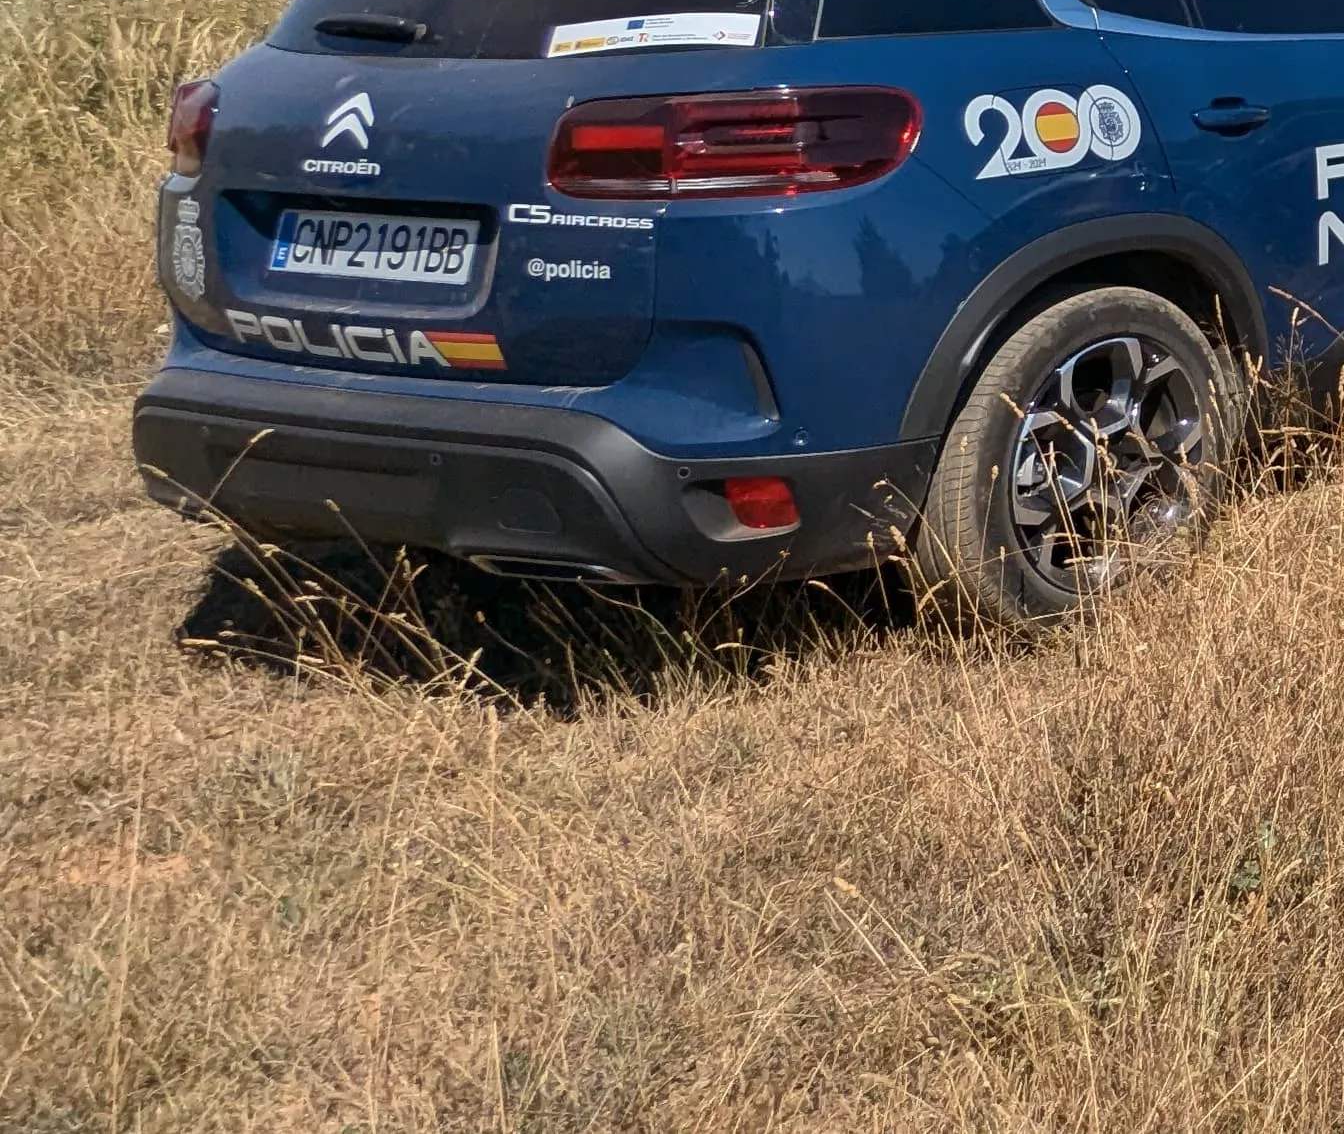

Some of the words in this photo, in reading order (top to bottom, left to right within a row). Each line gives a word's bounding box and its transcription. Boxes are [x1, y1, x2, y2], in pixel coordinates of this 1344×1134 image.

[964, 84, 1142, 180] 200
[276, 246, 288, 261] E
[292, 218, 469, 276] CNP2191BB
[527, 258, 611, 282] @policia
